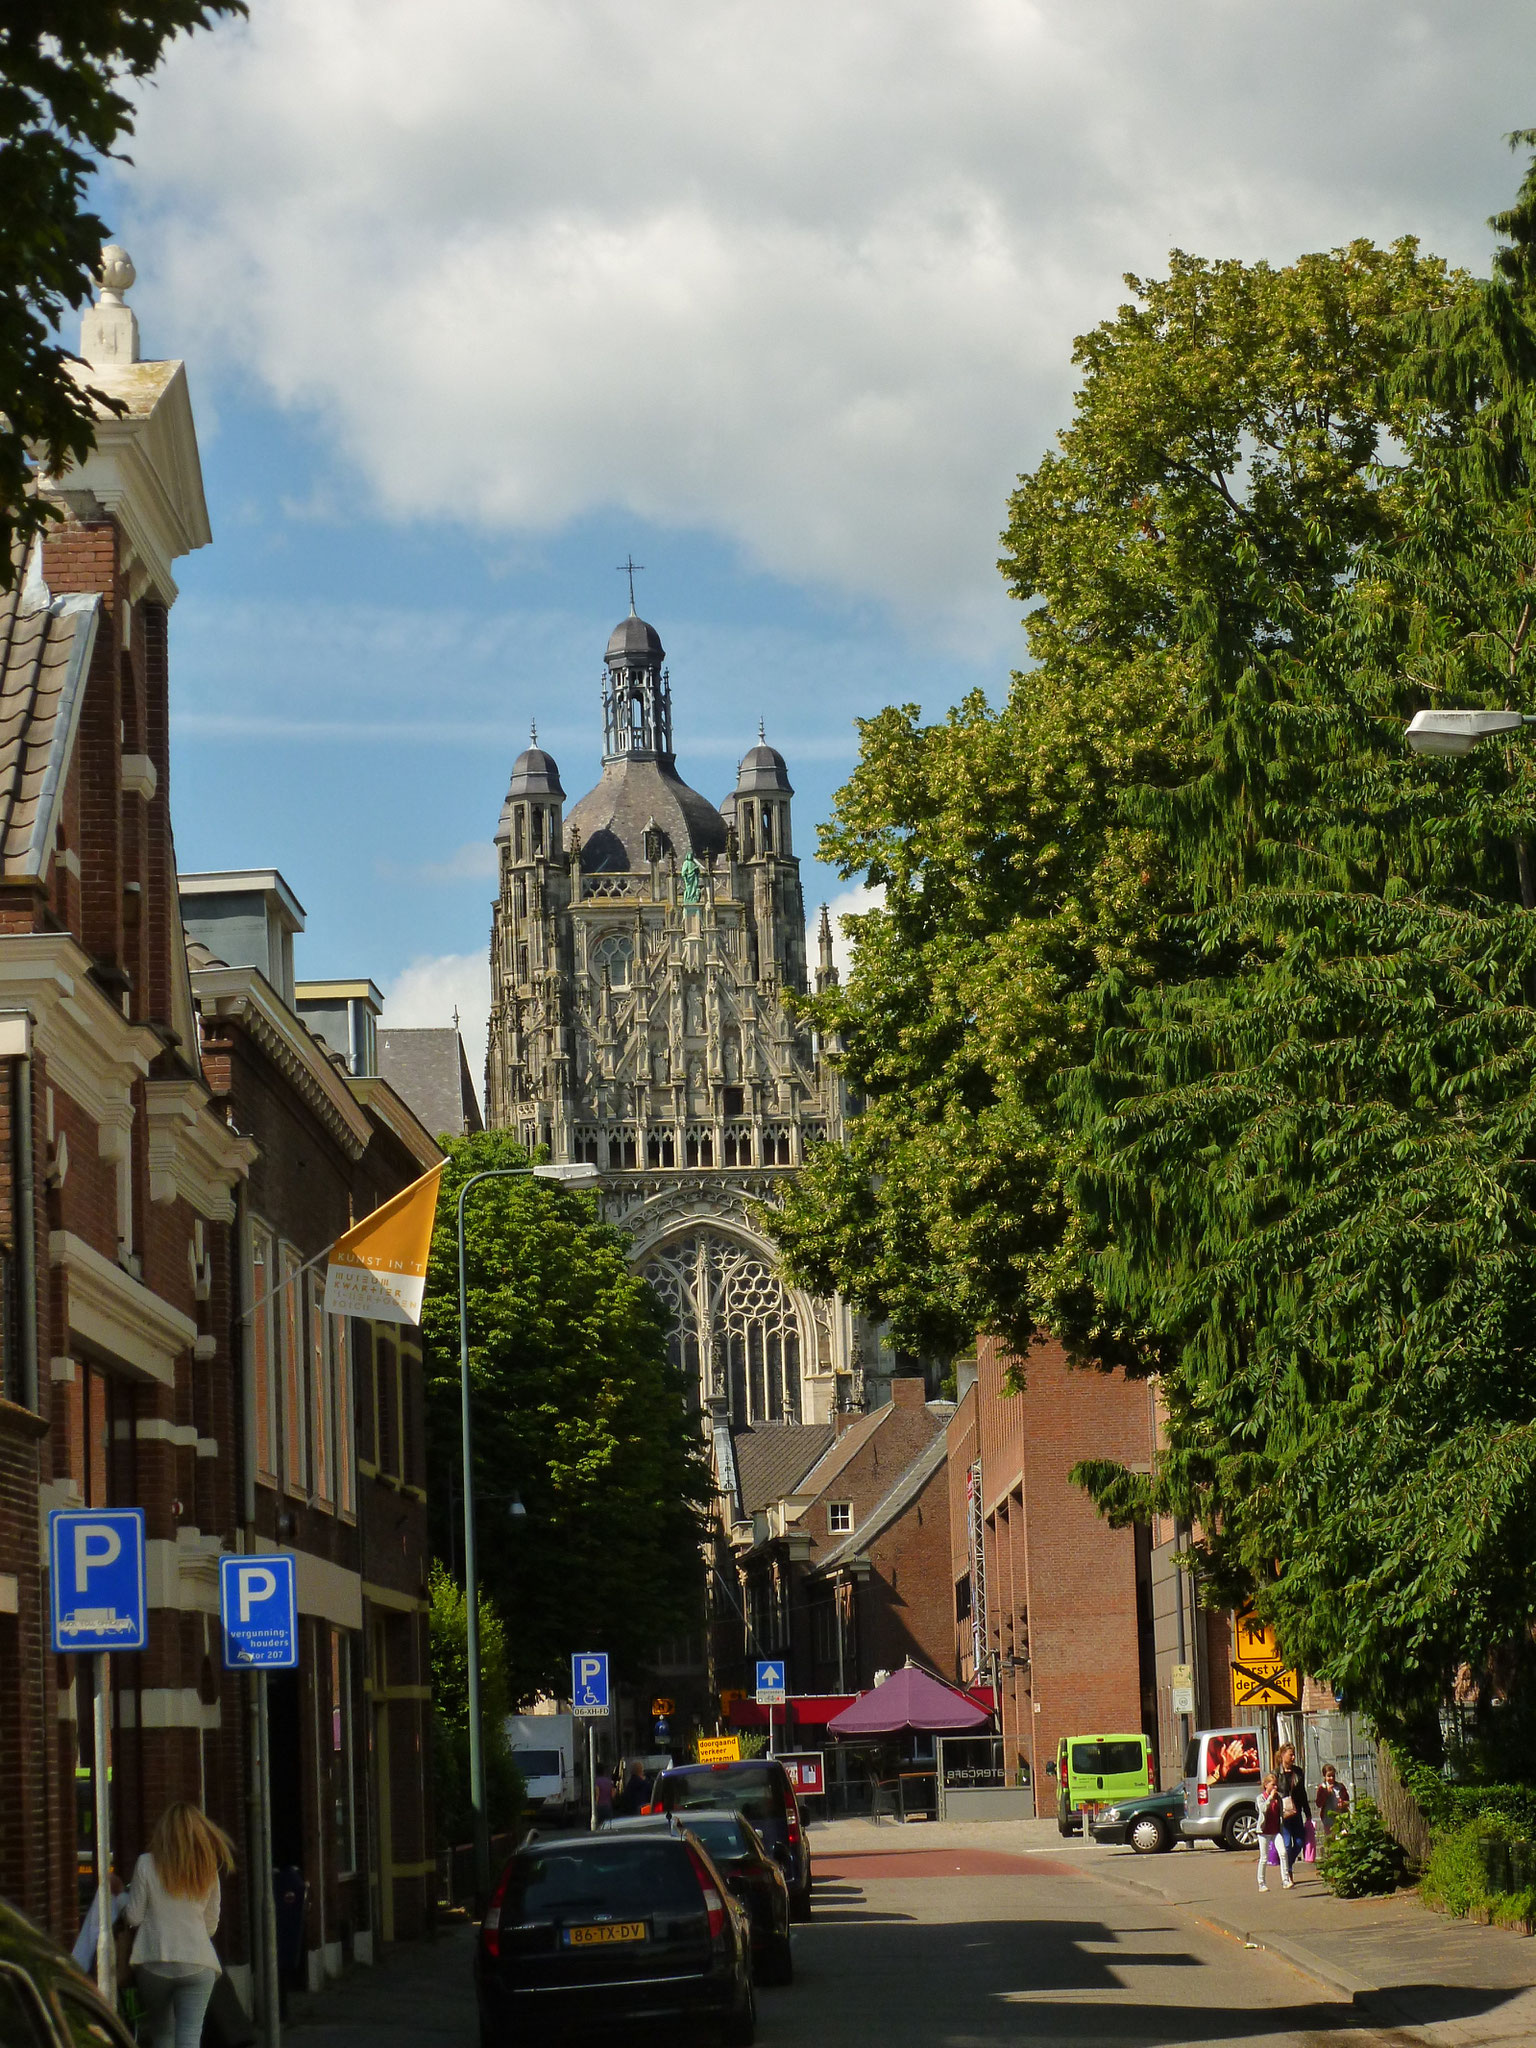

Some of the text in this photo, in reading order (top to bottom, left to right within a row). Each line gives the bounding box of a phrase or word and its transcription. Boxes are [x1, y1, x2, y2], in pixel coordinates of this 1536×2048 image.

[337, 1252, 423, 1273] KUNST IN 'T
[334, 1281, 401, 1298] KWARTIER
[74, 1524, 122, 1593] P
[238, 1567, 277, 1623] P
[230, 1628, 289, 1639] vergunning-
[250, 1639, 289, 1648] houders
[267, 1650, 284, 1659] 207
[580, 1658, 601, 1686] P
[1236, 1679, 1256, 1690] der
[699, 1738, 737, 1749] doorgaand
[700, 1747, 727, 1756] verkeer
[574, 1924, 641, 1942] 86-TX-DV
